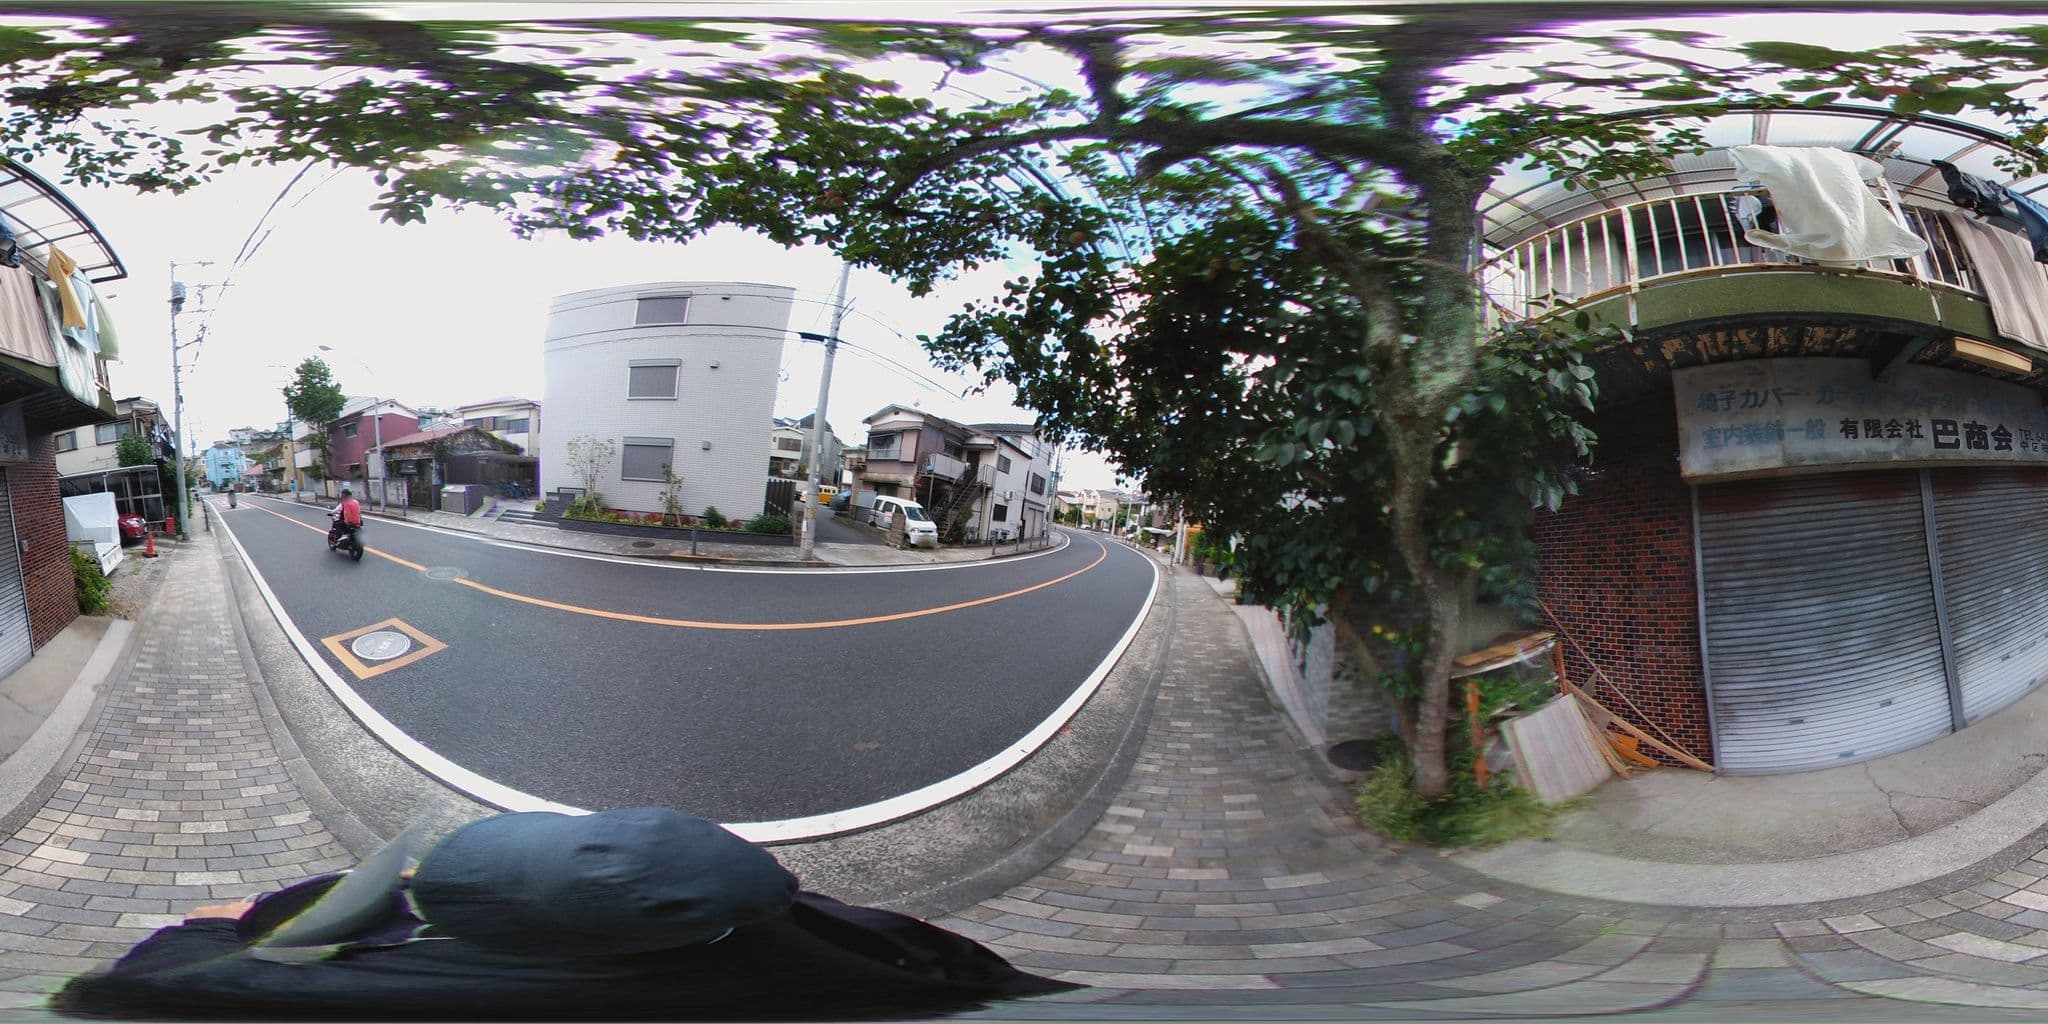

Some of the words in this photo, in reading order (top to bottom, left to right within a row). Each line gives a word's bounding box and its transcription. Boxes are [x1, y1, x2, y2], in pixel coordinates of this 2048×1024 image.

[1839, 418, 1924, 439] 有限会社
[1931, 419, 2013, 451] 巴商会
